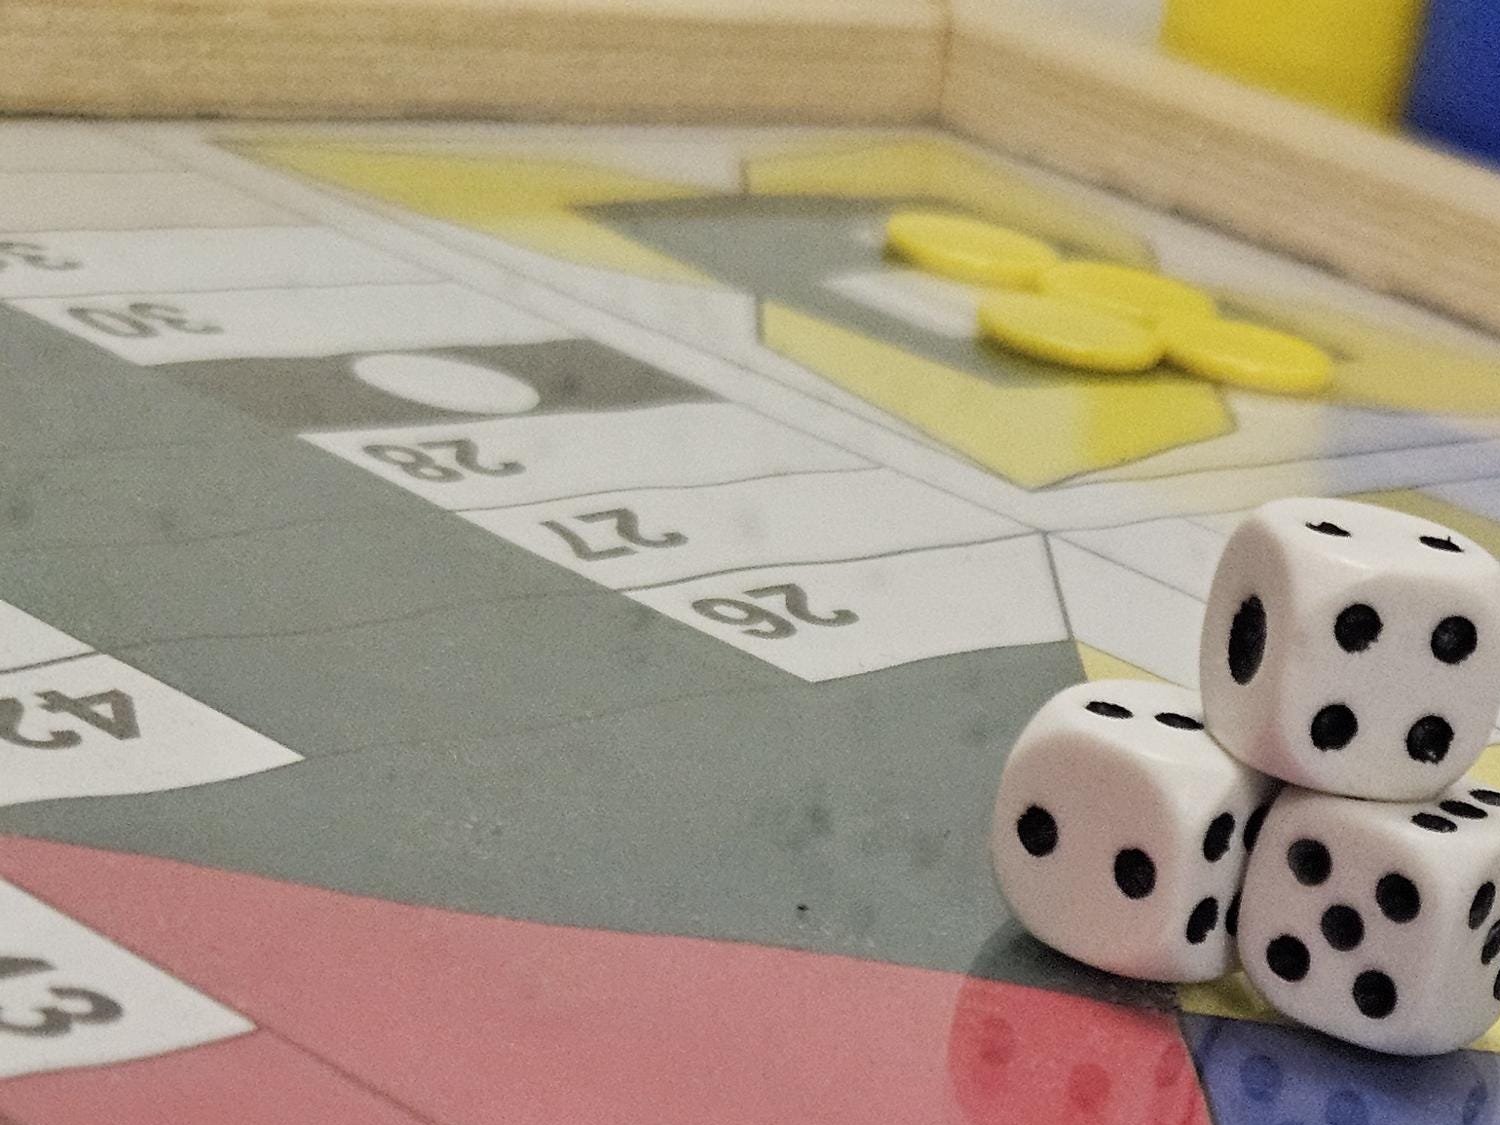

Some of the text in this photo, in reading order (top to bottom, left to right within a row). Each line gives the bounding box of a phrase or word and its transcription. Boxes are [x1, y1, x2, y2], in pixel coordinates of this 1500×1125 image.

[0, 241, 82, 271] 3
[66, 303, 224, 338] 30
[362, 438, 527, 483] 28
[540, 508, 689, 562] 27
[692, 583, 860, 640] 26
